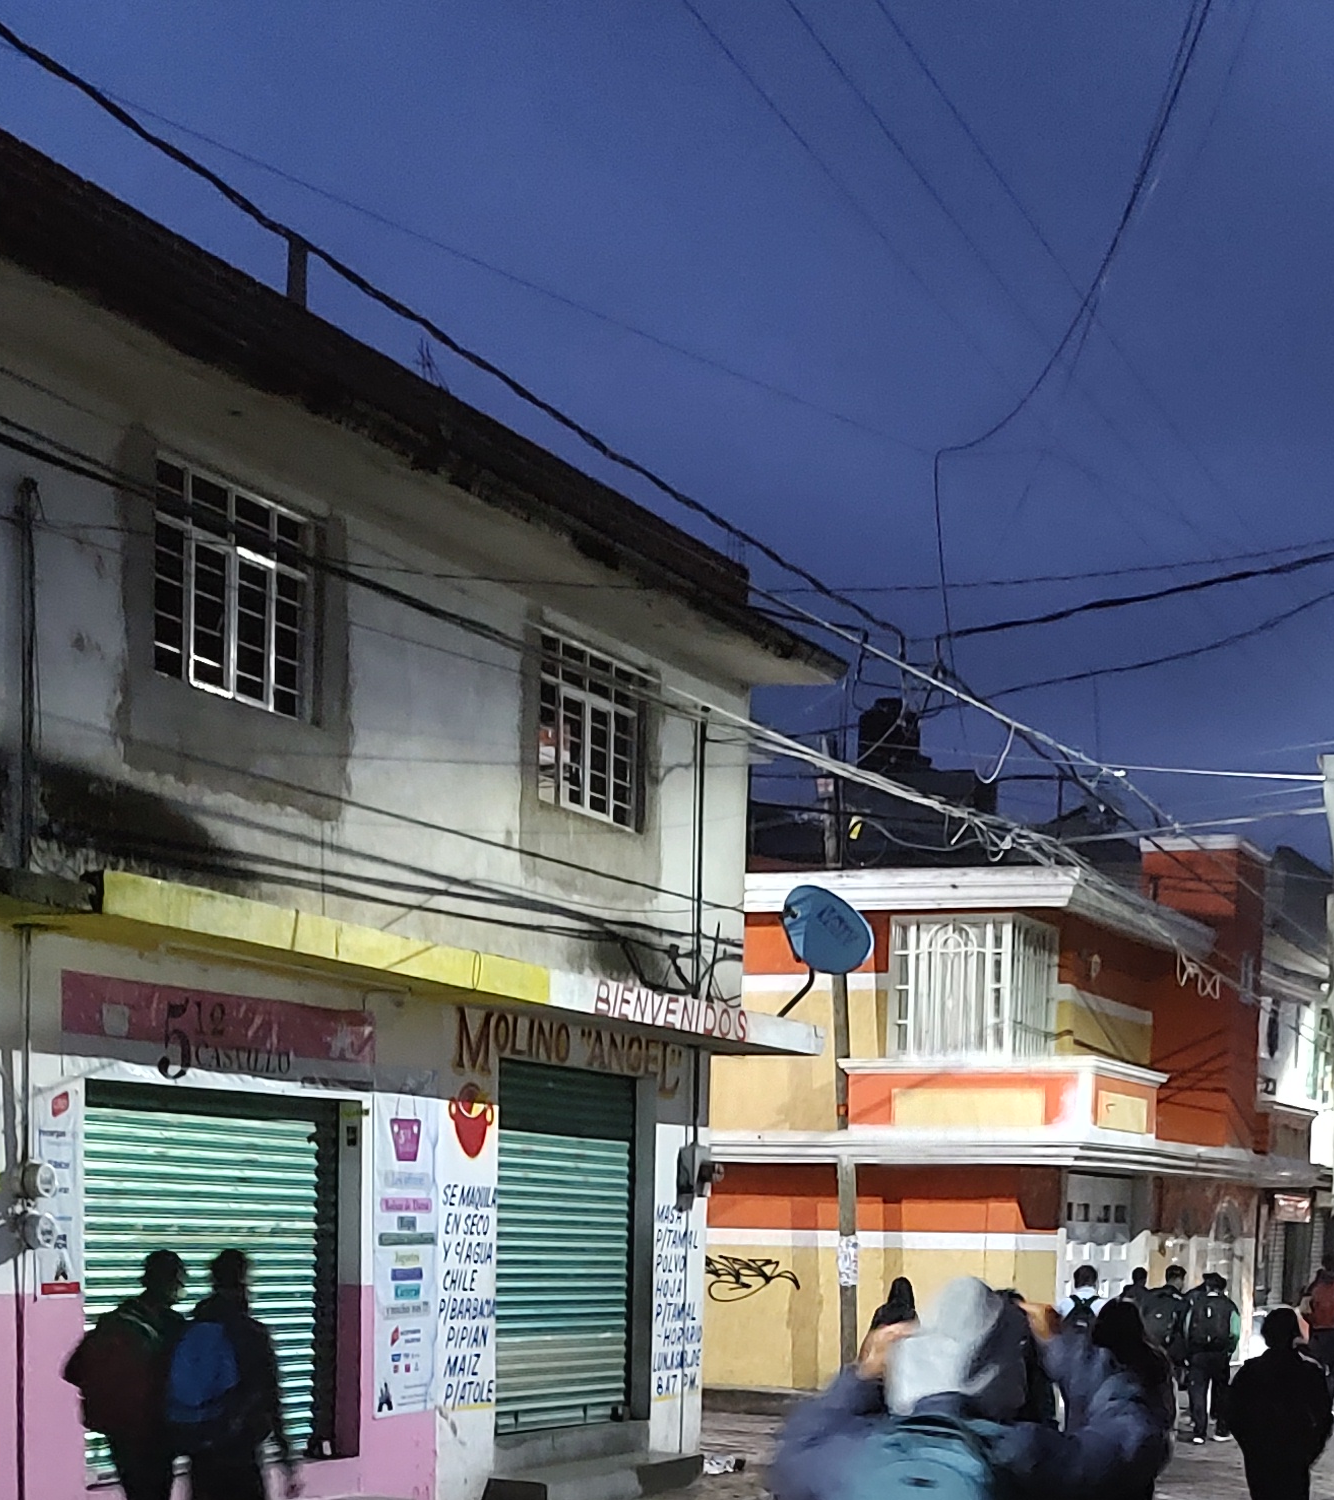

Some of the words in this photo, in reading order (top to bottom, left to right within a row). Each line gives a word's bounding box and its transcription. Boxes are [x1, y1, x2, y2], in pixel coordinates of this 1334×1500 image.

[593, 979, 748, 1042] BIENVENIDOS
[451, 1005, 571, 1076] MOLINO
[194, 1040, 291, 1074] CASTILLO
[442, 1184, 458, 1207] SE
[458, 1185, 497, 1211] MAQUILA
[445, 1212, 462, 1235] EN
[463, 1213, 490, 1236] SECO
[656, 1203, 682, 1225] MASA
[443, 1240, 451, 1263] Y
[655, 1229, 699, 1252] P/TAMAL
[655, 1253, 686, 1274] POLVO
[442, 1269, 479, 1292] CHILE
[655, 1278, 683, 1298] HOJA
[445, 1325, 489, 1349] PIPIAN
[443, 1353, 481, 1378] MAIZ
[443, 1379, 495, 1411] P/ATOLE
